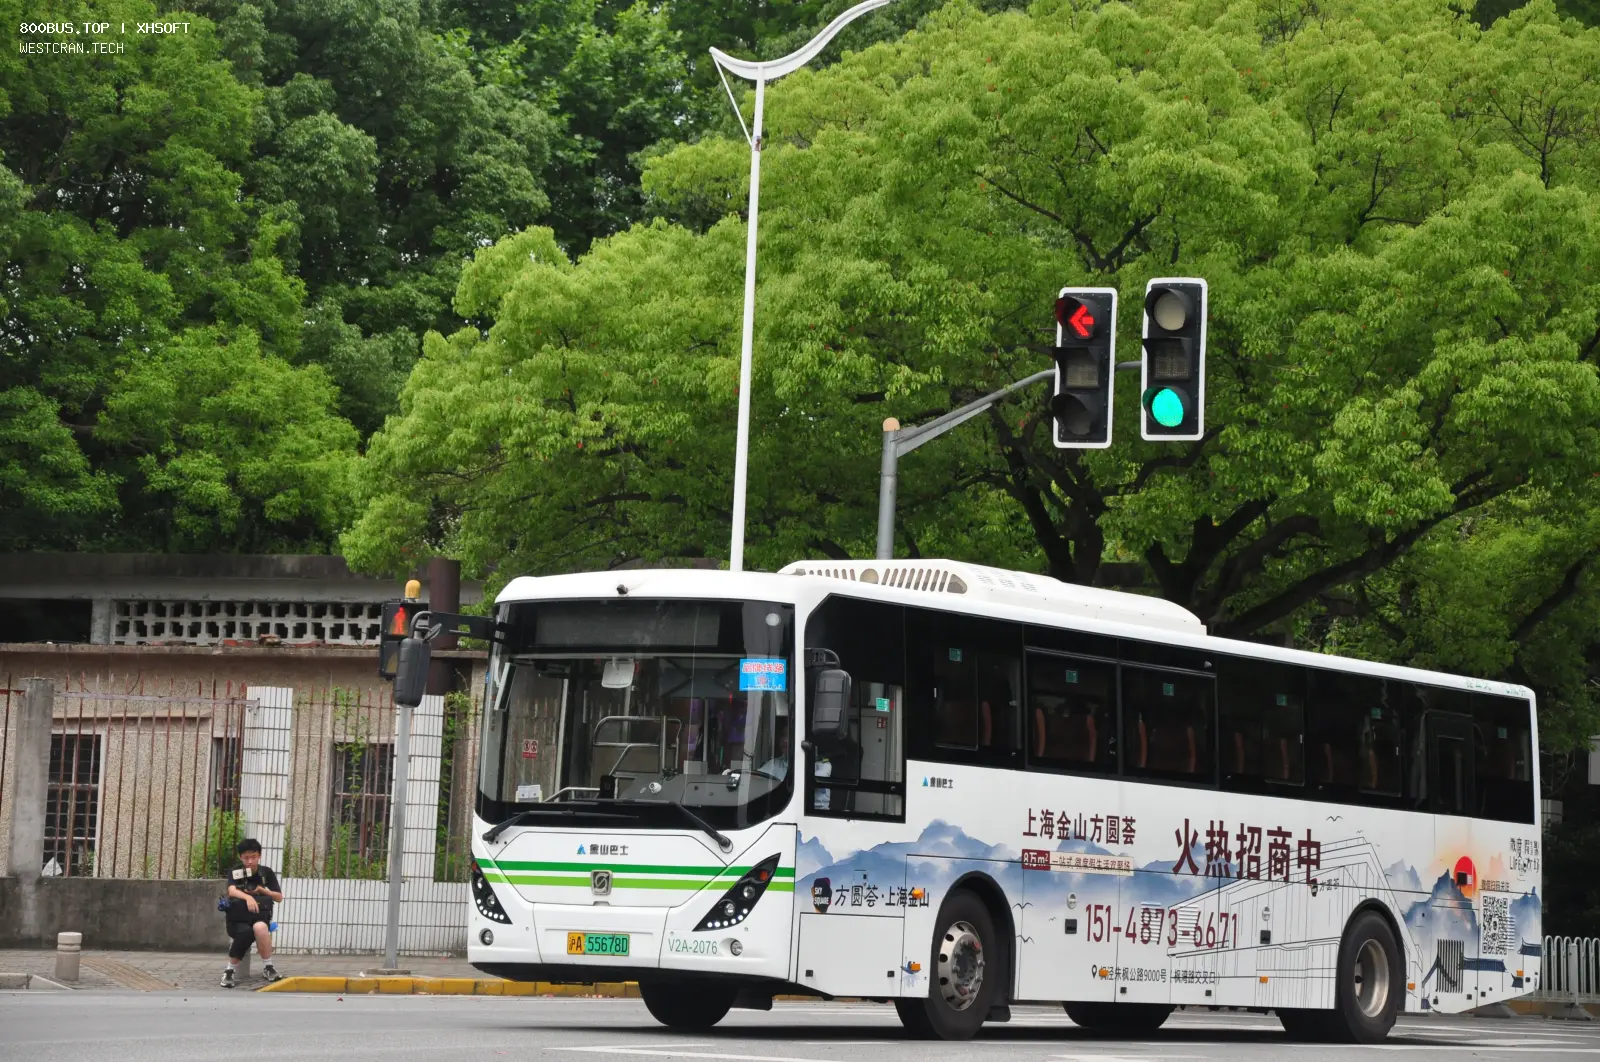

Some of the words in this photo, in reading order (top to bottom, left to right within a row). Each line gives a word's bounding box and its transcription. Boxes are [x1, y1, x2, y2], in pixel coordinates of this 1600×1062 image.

[1022, 808, 1136, 845] 上海金山方圆荟
[589, 844, 629, 856] 金山巴士
[1172, 818, 1321, 884] 火热招商中
[1086, 904, 1238, 949] 151-4873-6671
[587, 936, 628, 954] 55678D
[668, 938, 718, 955] V2A-2076
